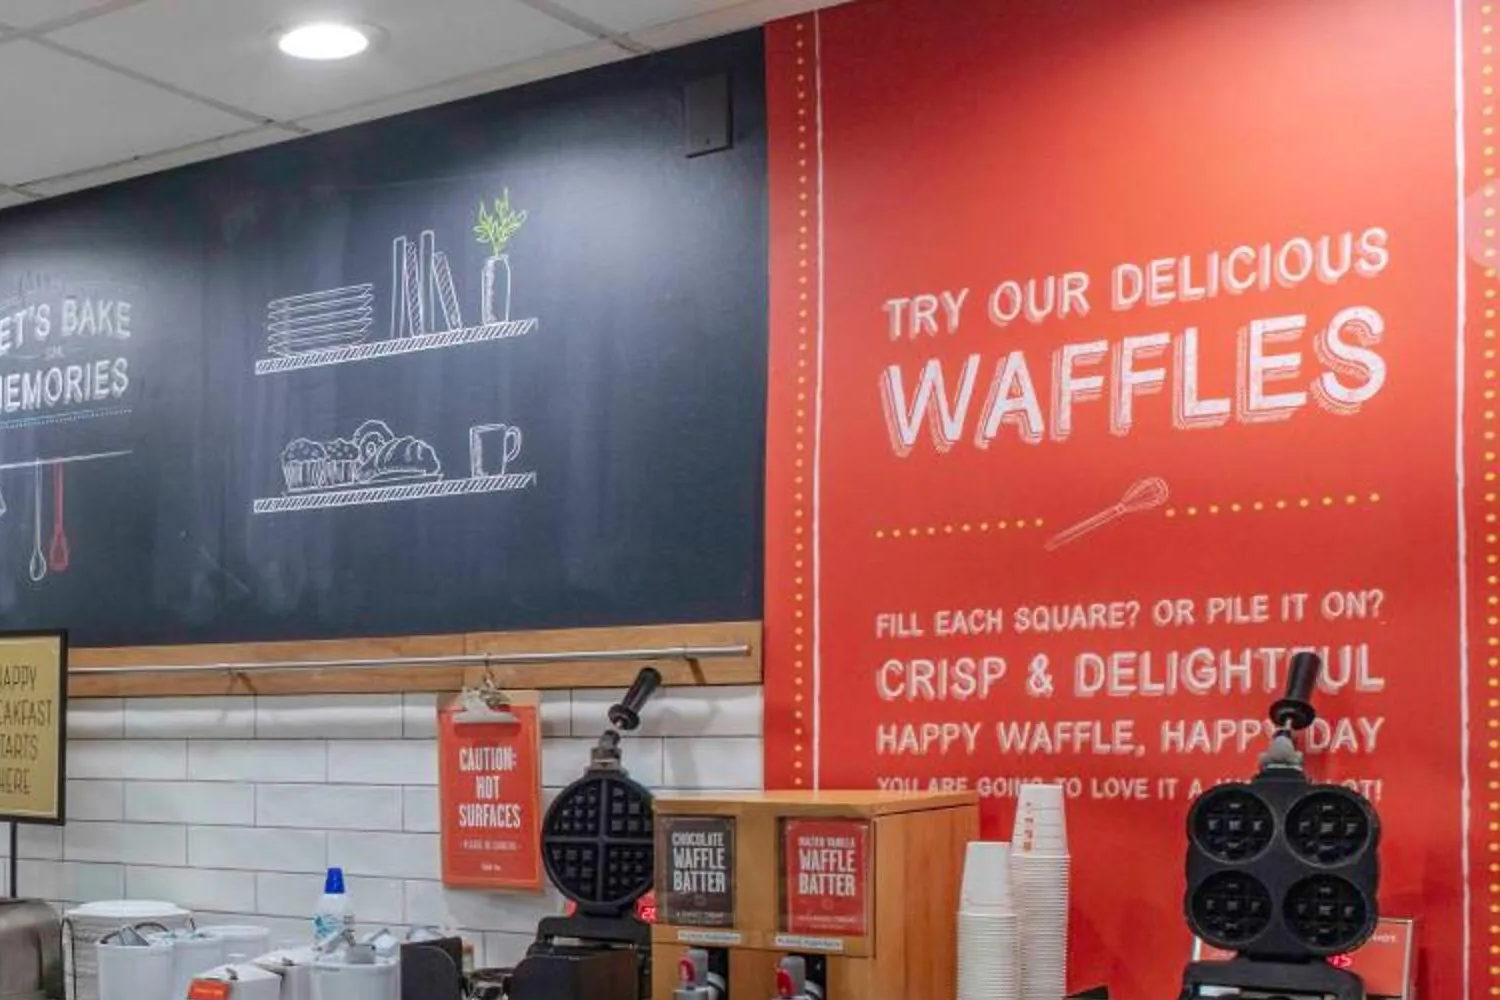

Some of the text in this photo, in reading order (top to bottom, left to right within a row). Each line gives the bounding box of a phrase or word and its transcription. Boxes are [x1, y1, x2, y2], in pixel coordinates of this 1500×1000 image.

[884, 227, 1388, 340] TRY OUR DELICIOUS
[62, 297, 132, 340] BAKE
[878, 305, 1387, 458] WAFFLES
[876, 588, 1384, 638] FILL EACH SQUARE? OR PILE IT ON?
[876, 657, 1007, 700] CRISP
[1027, 653, 1054, 697] &
[876, 721, 981, 755] HAPPY
[996, 719, 1146, 757] WAFFLE,
[1306, 716, 1385, 752] DAY
[459, 747, 517, 772] CAUTION:
[476, 776, 500, 799] HOT
[977, 777, 1043, 799] GOI
[1091, 777, 1150, 799] LOVE
[1158, 778, 1178, 800] IT
[459, 803, 521, 828] SURFACES
[671, 832, 724, 847] CHOCOLATE
[673, 847, 726, 870] WAFFLE
[799, 848, 856, 872] WAFFLE
[673, 870, 725, 893] BATTER
[798, 872, 856, 896] BATTER
